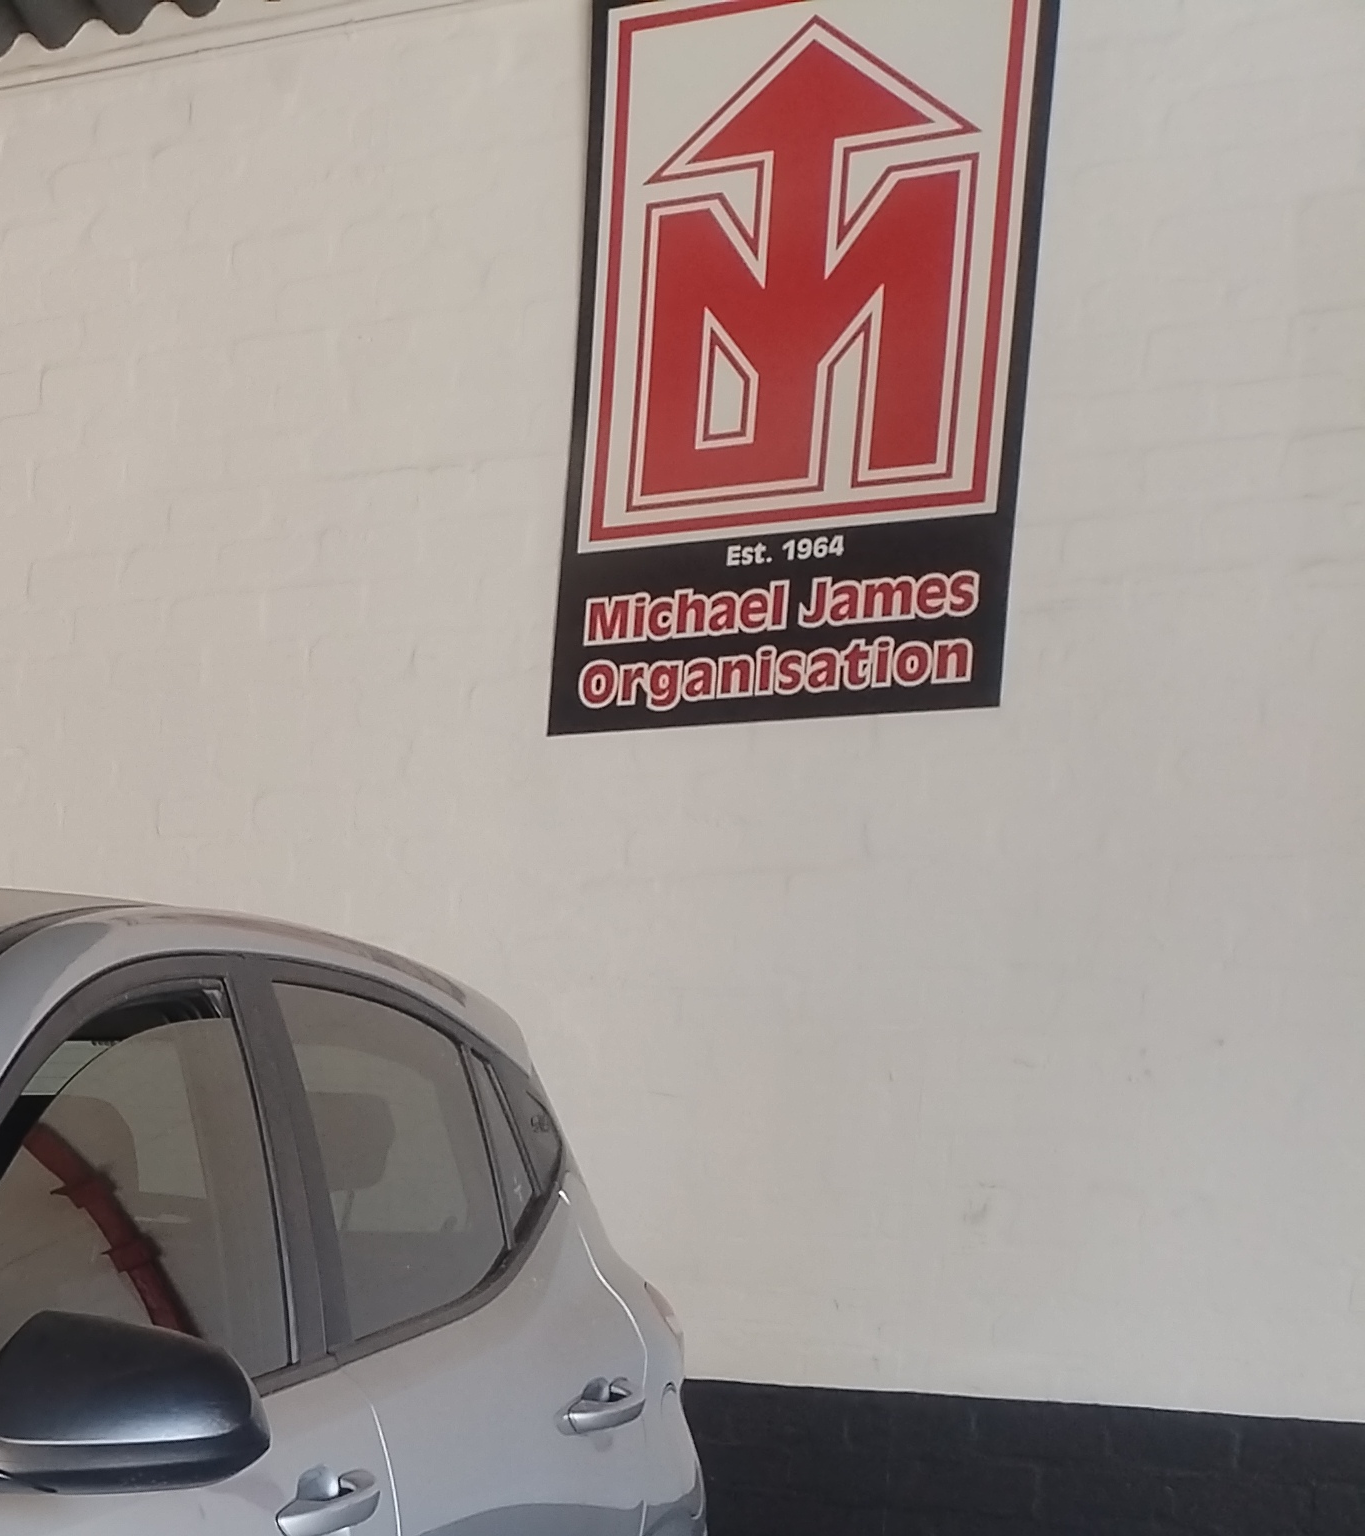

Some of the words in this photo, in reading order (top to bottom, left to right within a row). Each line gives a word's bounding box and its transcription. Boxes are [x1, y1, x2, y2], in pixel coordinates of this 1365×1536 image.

[725, 544, 773, 567] Est.
[781, 534, 845, 561] 1964
[583, 579, 790, 646] Michael
[797, 569, 980, 629] James
[578, 636, 974, 712] Organisation
